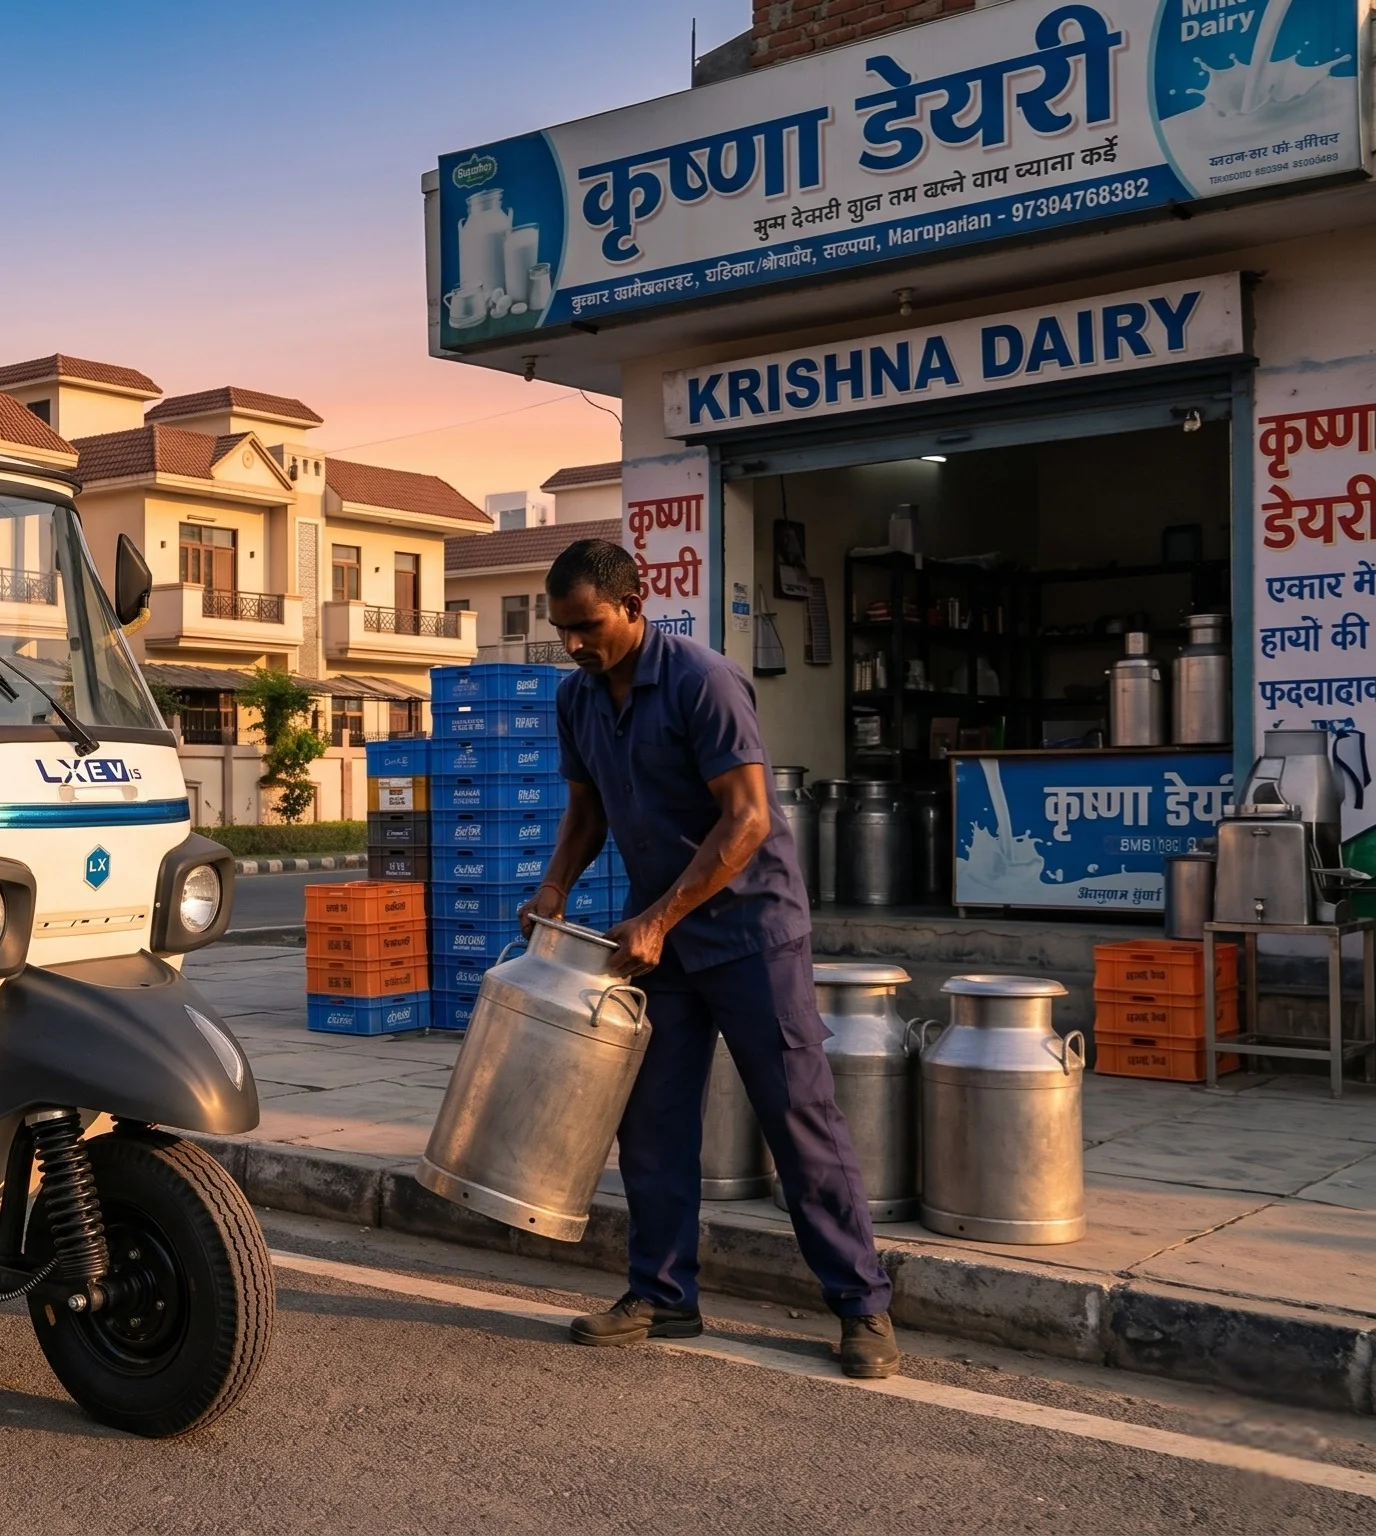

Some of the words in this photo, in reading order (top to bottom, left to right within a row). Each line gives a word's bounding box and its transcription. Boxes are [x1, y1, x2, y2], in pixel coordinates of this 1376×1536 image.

[1181, 10, 1256, 42] Dairy
[578, 106, 829, 262] कृष्णा
[855, 4, 1122, 170] डेयरी
[686, 334, 961, 425] KRISHNA
[980, 290, 1203, 379] DAIRY
[628, 494, 704, 550] कृष्णा
[1265, 572, 1346, 603] एकार
[1331, 612, 1370, 651] की
[1043, 786, 1152, 842] कृष्णा
[89, 857, 107, 873] LX
